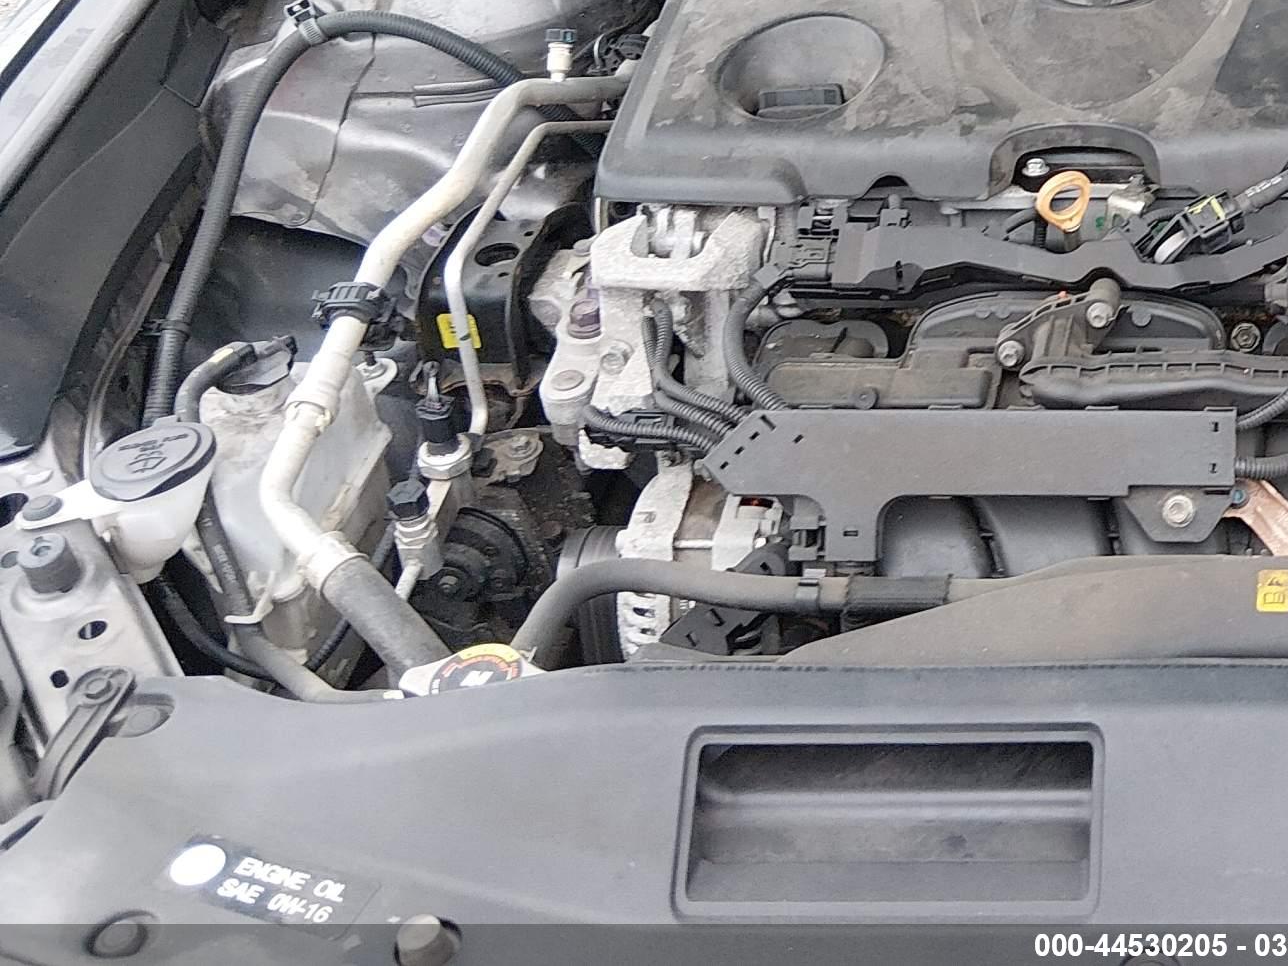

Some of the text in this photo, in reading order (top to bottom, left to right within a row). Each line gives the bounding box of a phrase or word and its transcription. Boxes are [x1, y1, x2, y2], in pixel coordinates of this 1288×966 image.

[217, 878, 334, 923] SAE 0W-16
[233, 856, 346, 902] ENGINE OIL
